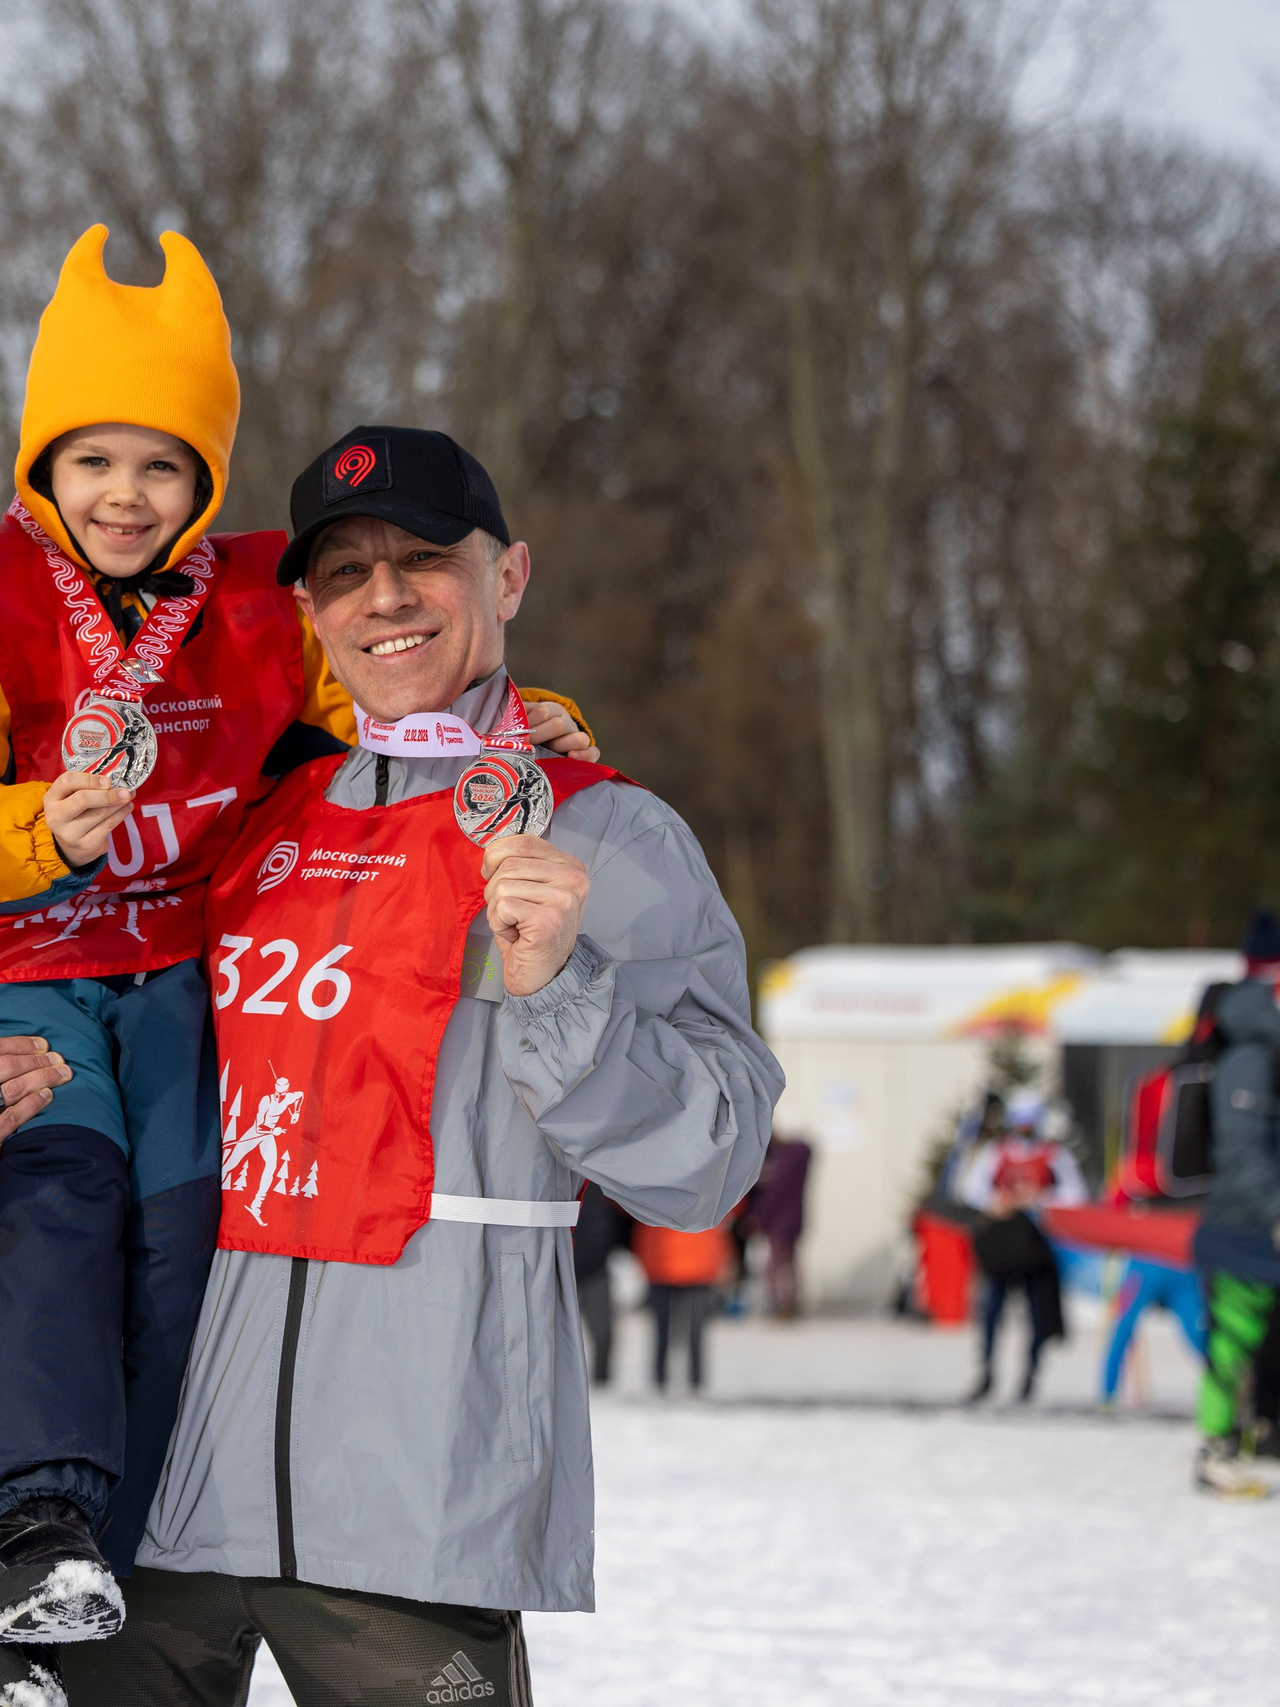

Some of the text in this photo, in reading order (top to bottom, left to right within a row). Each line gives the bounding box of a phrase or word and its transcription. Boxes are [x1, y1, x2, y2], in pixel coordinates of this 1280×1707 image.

[154, 718, 210, 735] анспорт
[79, 739, 101, 748] 2026
[403, 729, 429, 742] 22.02.2026
[472, 793, 494, 802] 2026
[308, 848, 407, 867] Московский
[300, 867, 379, 883] транспорт
[215, 933, 354, 1021] 326
[426, 1681, 496, 1704] adidas
